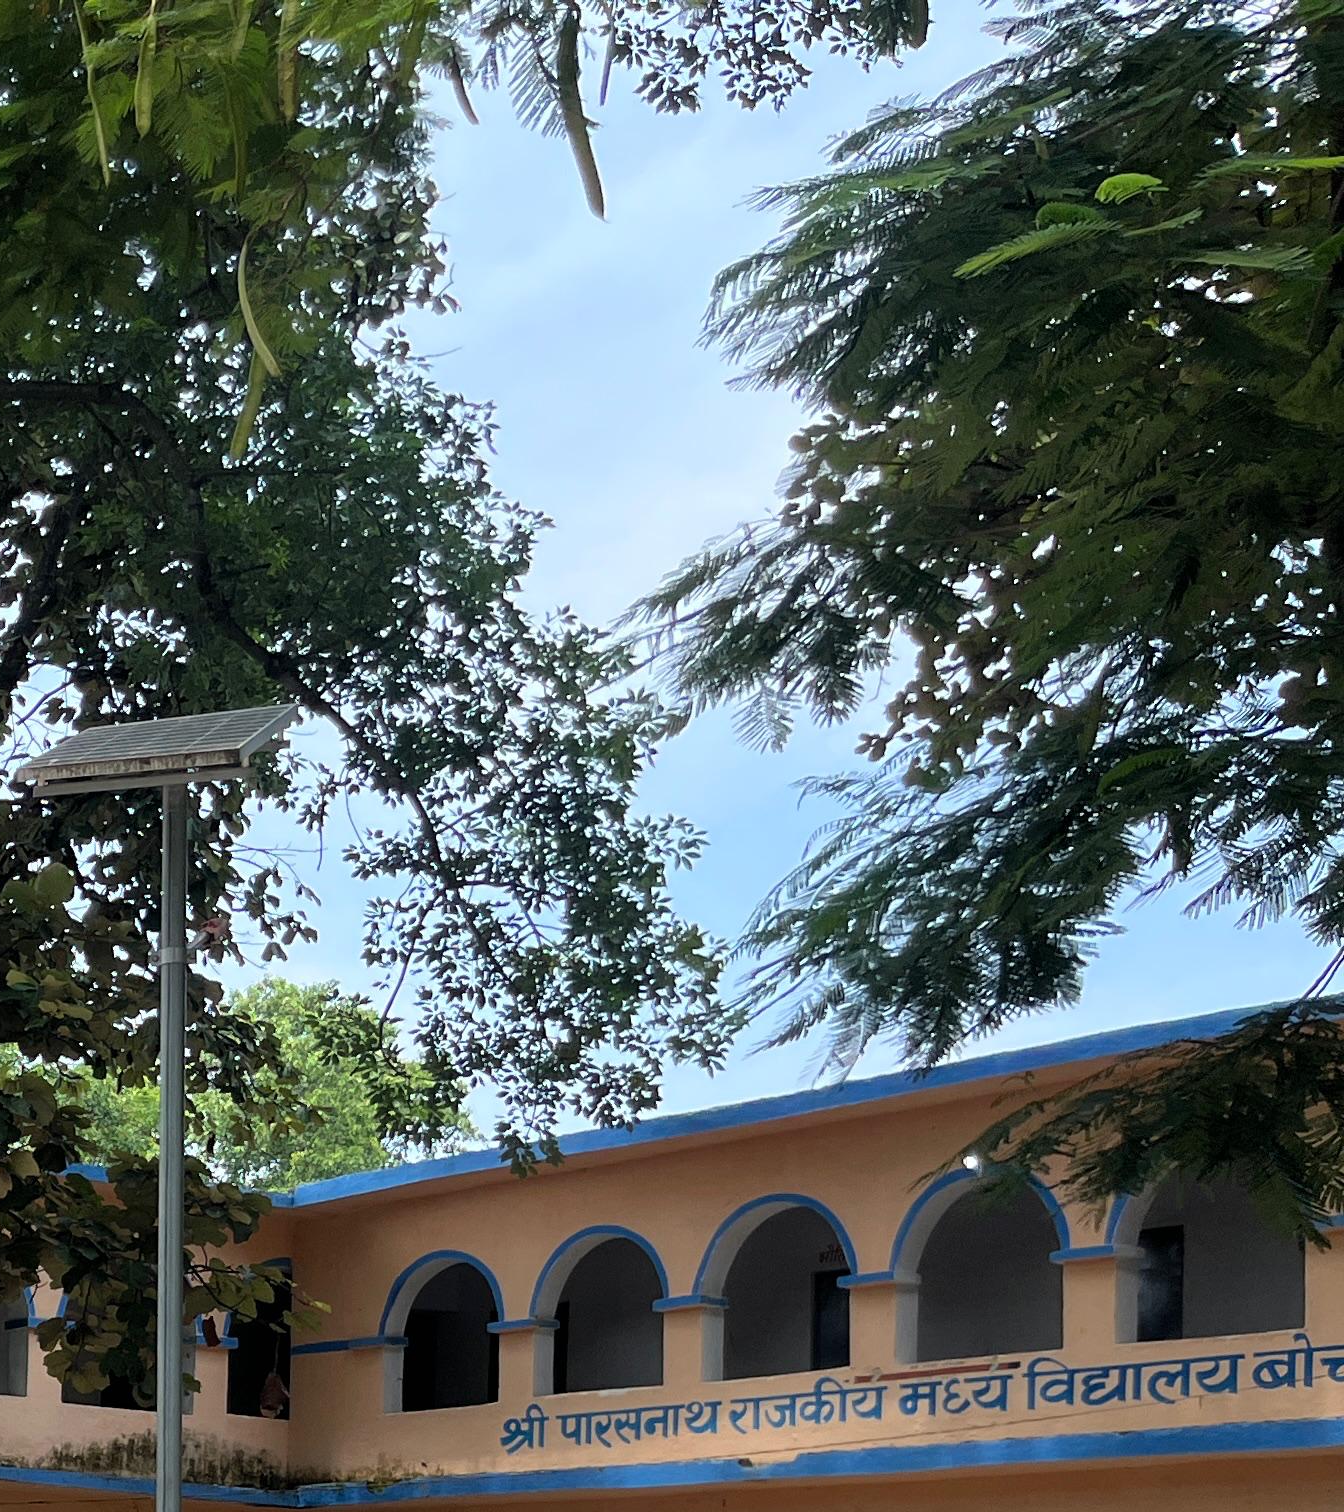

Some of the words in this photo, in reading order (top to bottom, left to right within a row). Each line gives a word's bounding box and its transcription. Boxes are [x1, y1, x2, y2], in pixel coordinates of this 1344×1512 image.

[499, 1403, 549, 1455] श्री
[556, 1400, 721, 1447] पारसनाथ
[730, 1376, 888, 1434] राजकीय
[900, 1370, 1013, 1417] मध्य
[1023, 1356, 1245, 1411] विद्यालय
